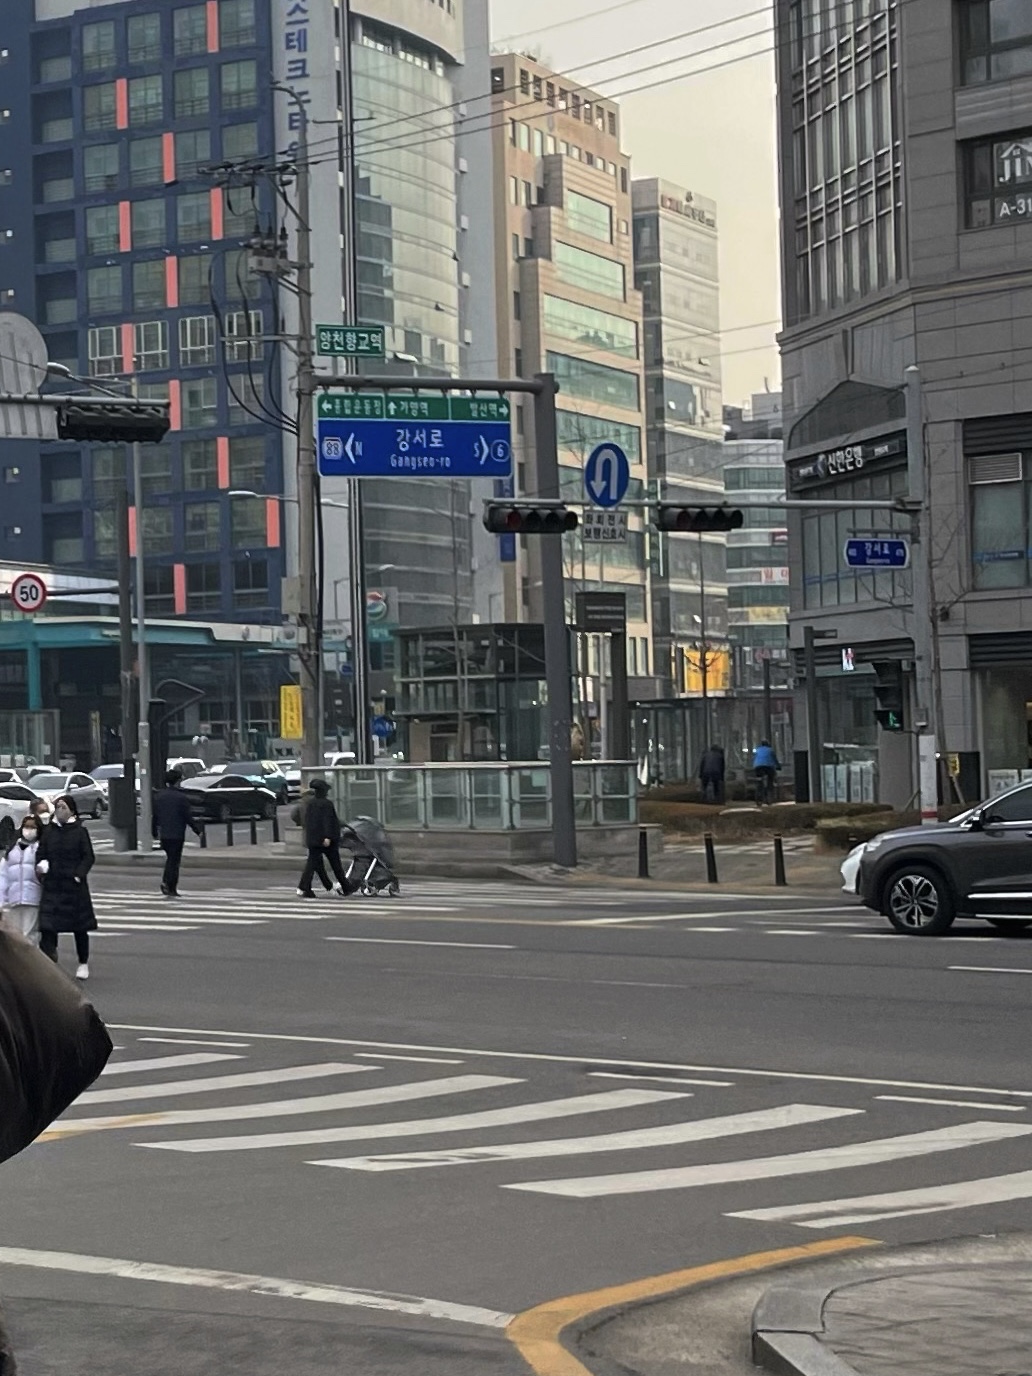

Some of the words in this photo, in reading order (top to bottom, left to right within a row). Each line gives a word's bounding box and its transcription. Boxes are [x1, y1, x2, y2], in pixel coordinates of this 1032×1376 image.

[320, 331, 382, 351] 양천향교역
[354, 441, 363, 456] N
[396, 428, 445, 451] 강서로
[390, 453, 451, 470] Gangseo-ro
[828, 445, 864, 474] 신한은행
[19, 582, 39, 601] 50
